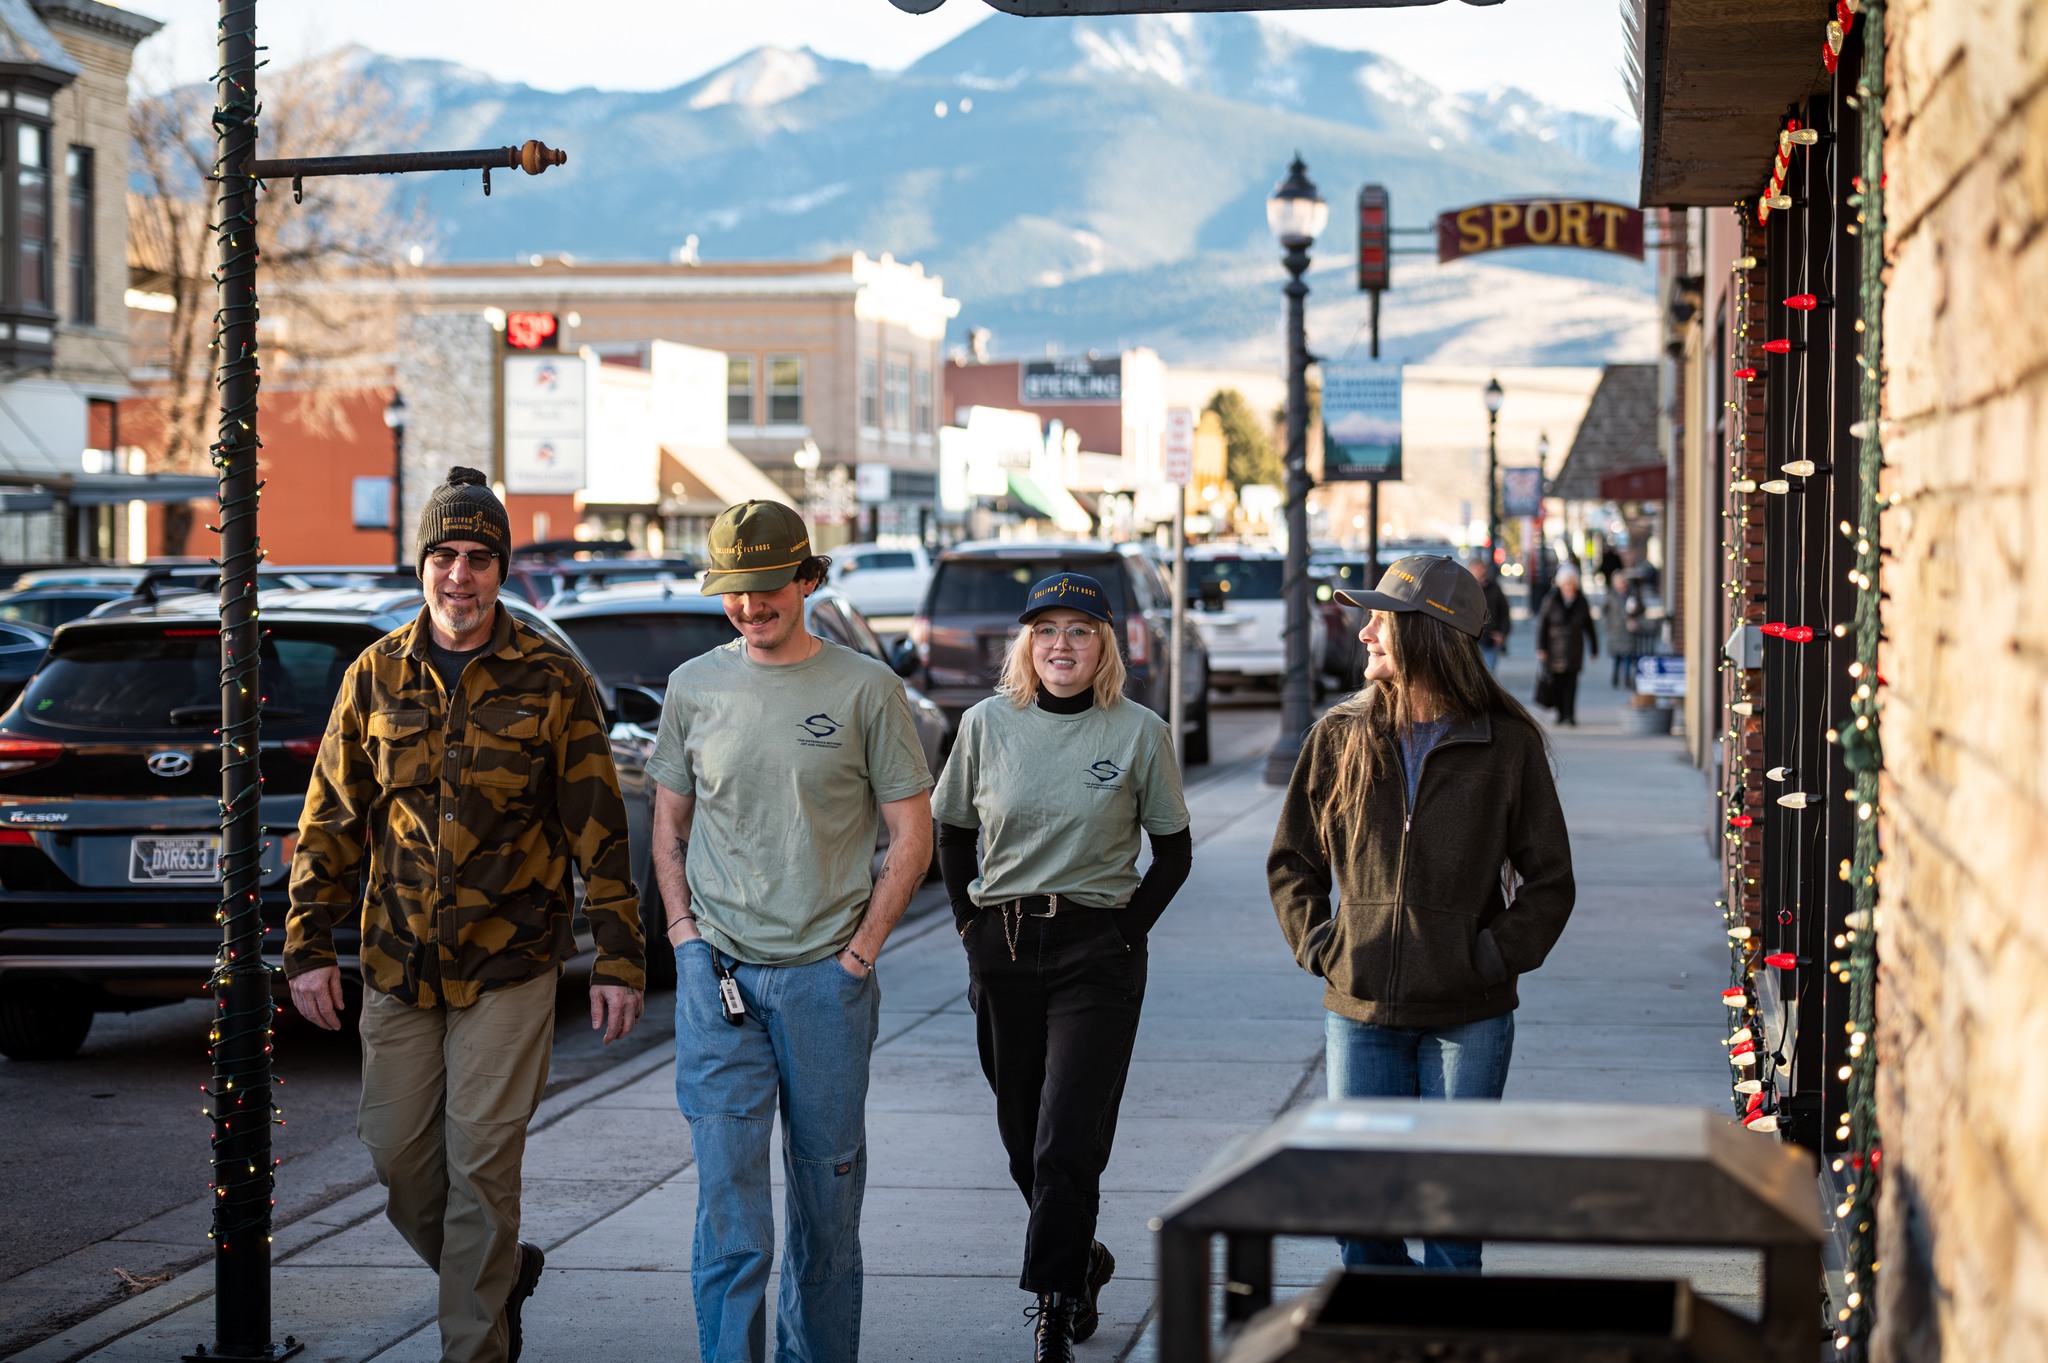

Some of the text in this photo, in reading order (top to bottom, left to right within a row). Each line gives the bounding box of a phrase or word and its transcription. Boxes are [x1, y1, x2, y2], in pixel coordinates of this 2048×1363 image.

[1456, 201, 1628, 252] SPORT
[1025, 374, 1120, 398] STERLING
[755, 543, 771, 552] RODS
[1399, 571, 1415, 583] RODS
[1034, 585, 1096, 599] SULLIVAN FLY RODS
[10, 811, 69, 822] TUCSON
[156, 840, 199, 848] MONTANA
[153, 848, 207, 870] DXR633
